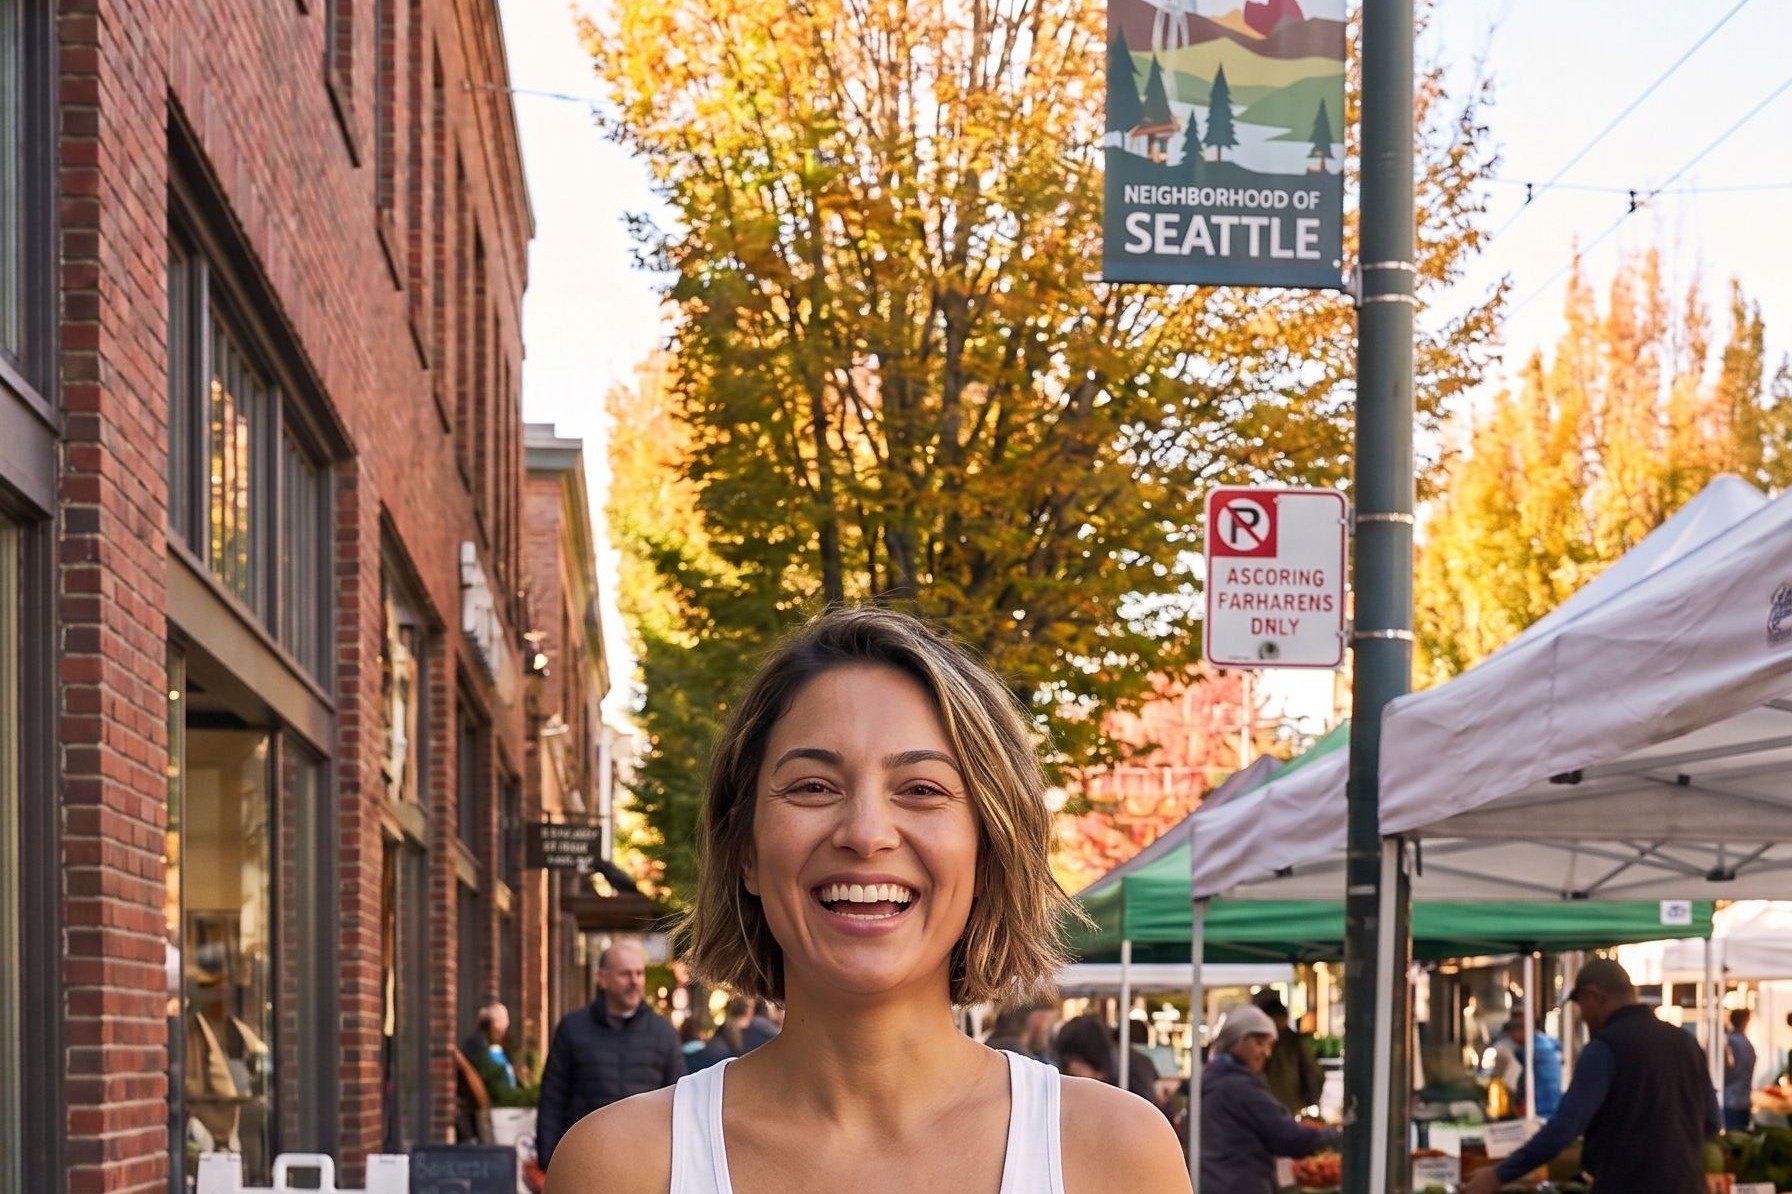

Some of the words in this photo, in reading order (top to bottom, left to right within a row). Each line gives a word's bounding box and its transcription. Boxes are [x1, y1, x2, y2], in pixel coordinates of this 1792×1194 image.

[1124, 185, 1288, 208] NEIGHBORHOOD
[1293, 190, 1321, 209] OF
[1124, 211, 1321, 260] SEATTLE
[1226, 568, 1325, 588] ASCORING
